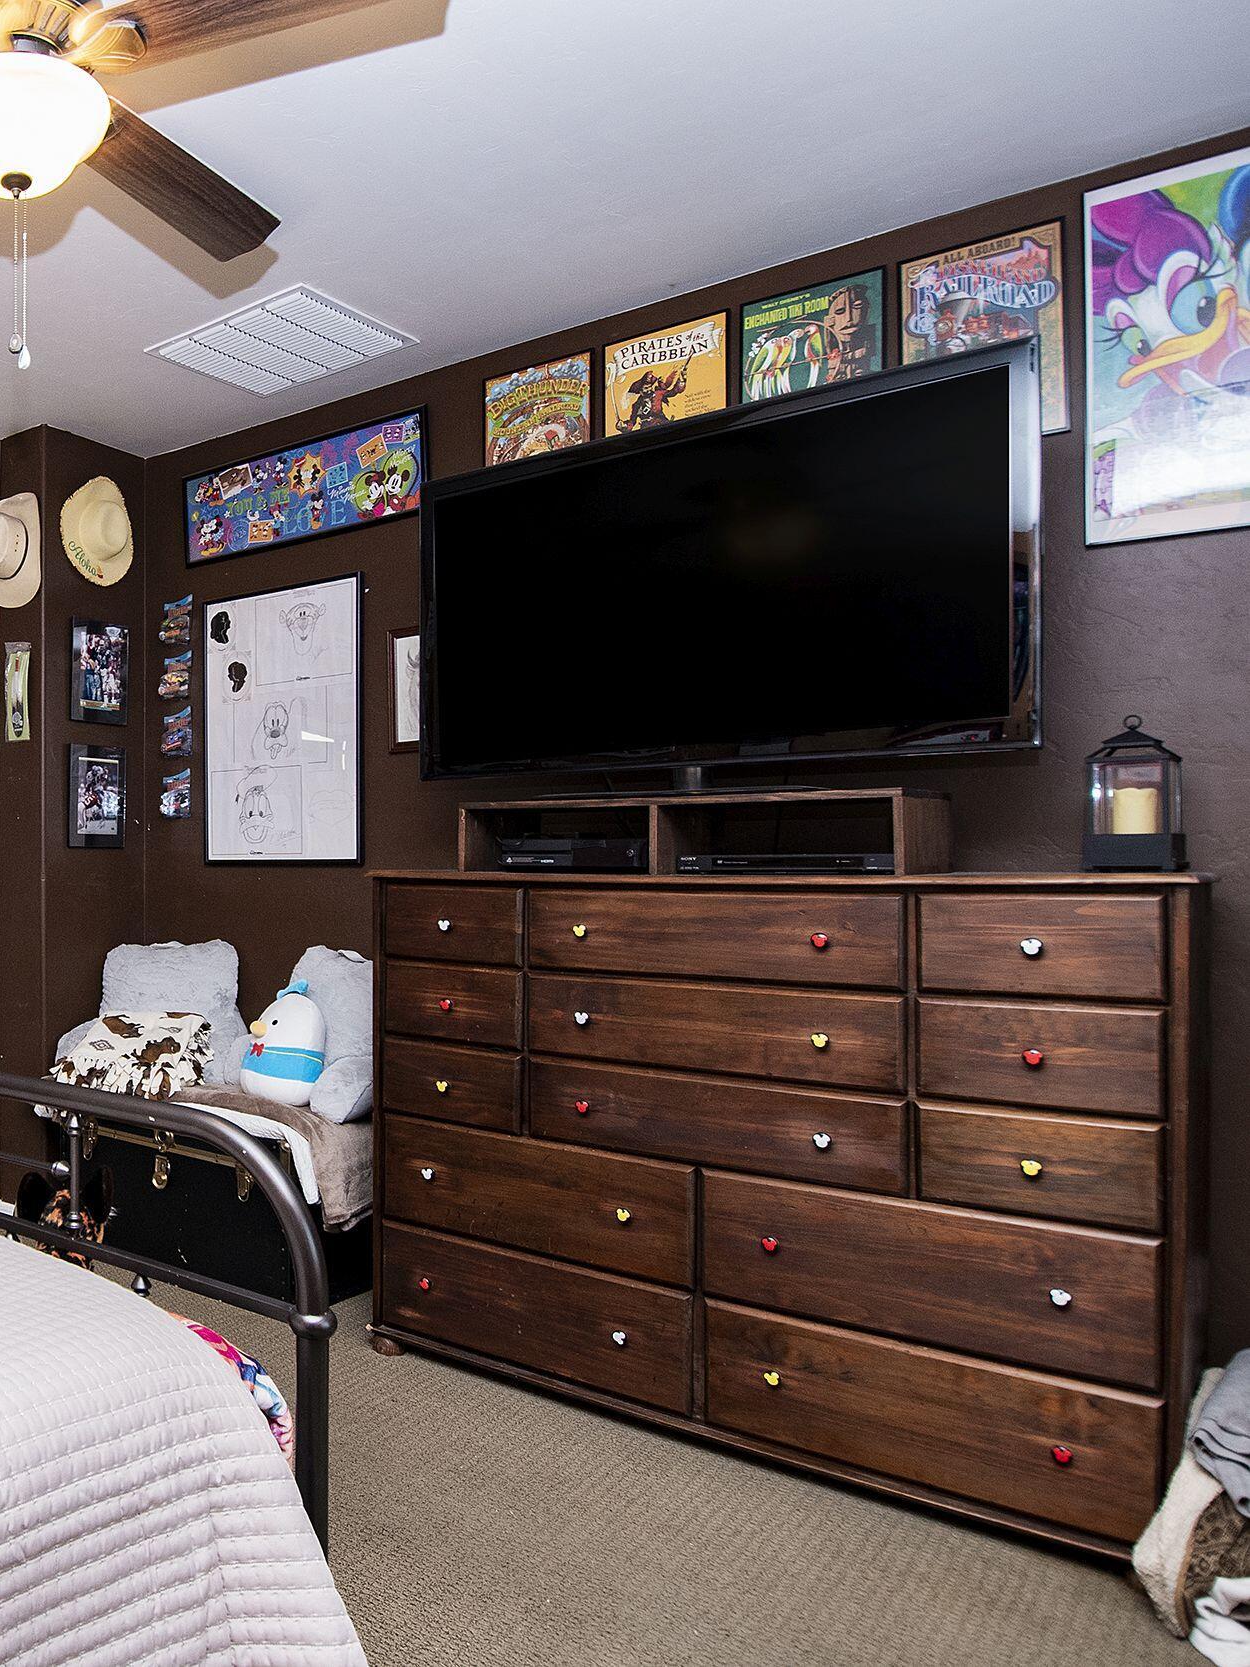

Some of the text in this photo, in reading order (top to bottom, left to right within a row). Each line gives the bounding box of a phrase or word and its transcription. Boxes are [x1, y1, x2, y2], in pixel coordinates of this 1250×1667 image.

[943, 252, 964, 265] ALL
[761, 300, 779, 309] WALT
[915, 274, 1056, 318] RAILROAD
[744, 296, 829, 329] ENCHANTED TIKI ROOM
[620, 334, 682, 359] PIRATES
[685, 331, 693, 340] of
[621, 340, 710, 370] CARIBBEAN
[490, 379, 590, 420] BIG THUNDER
[68, 541, 97, 577] Aloha
